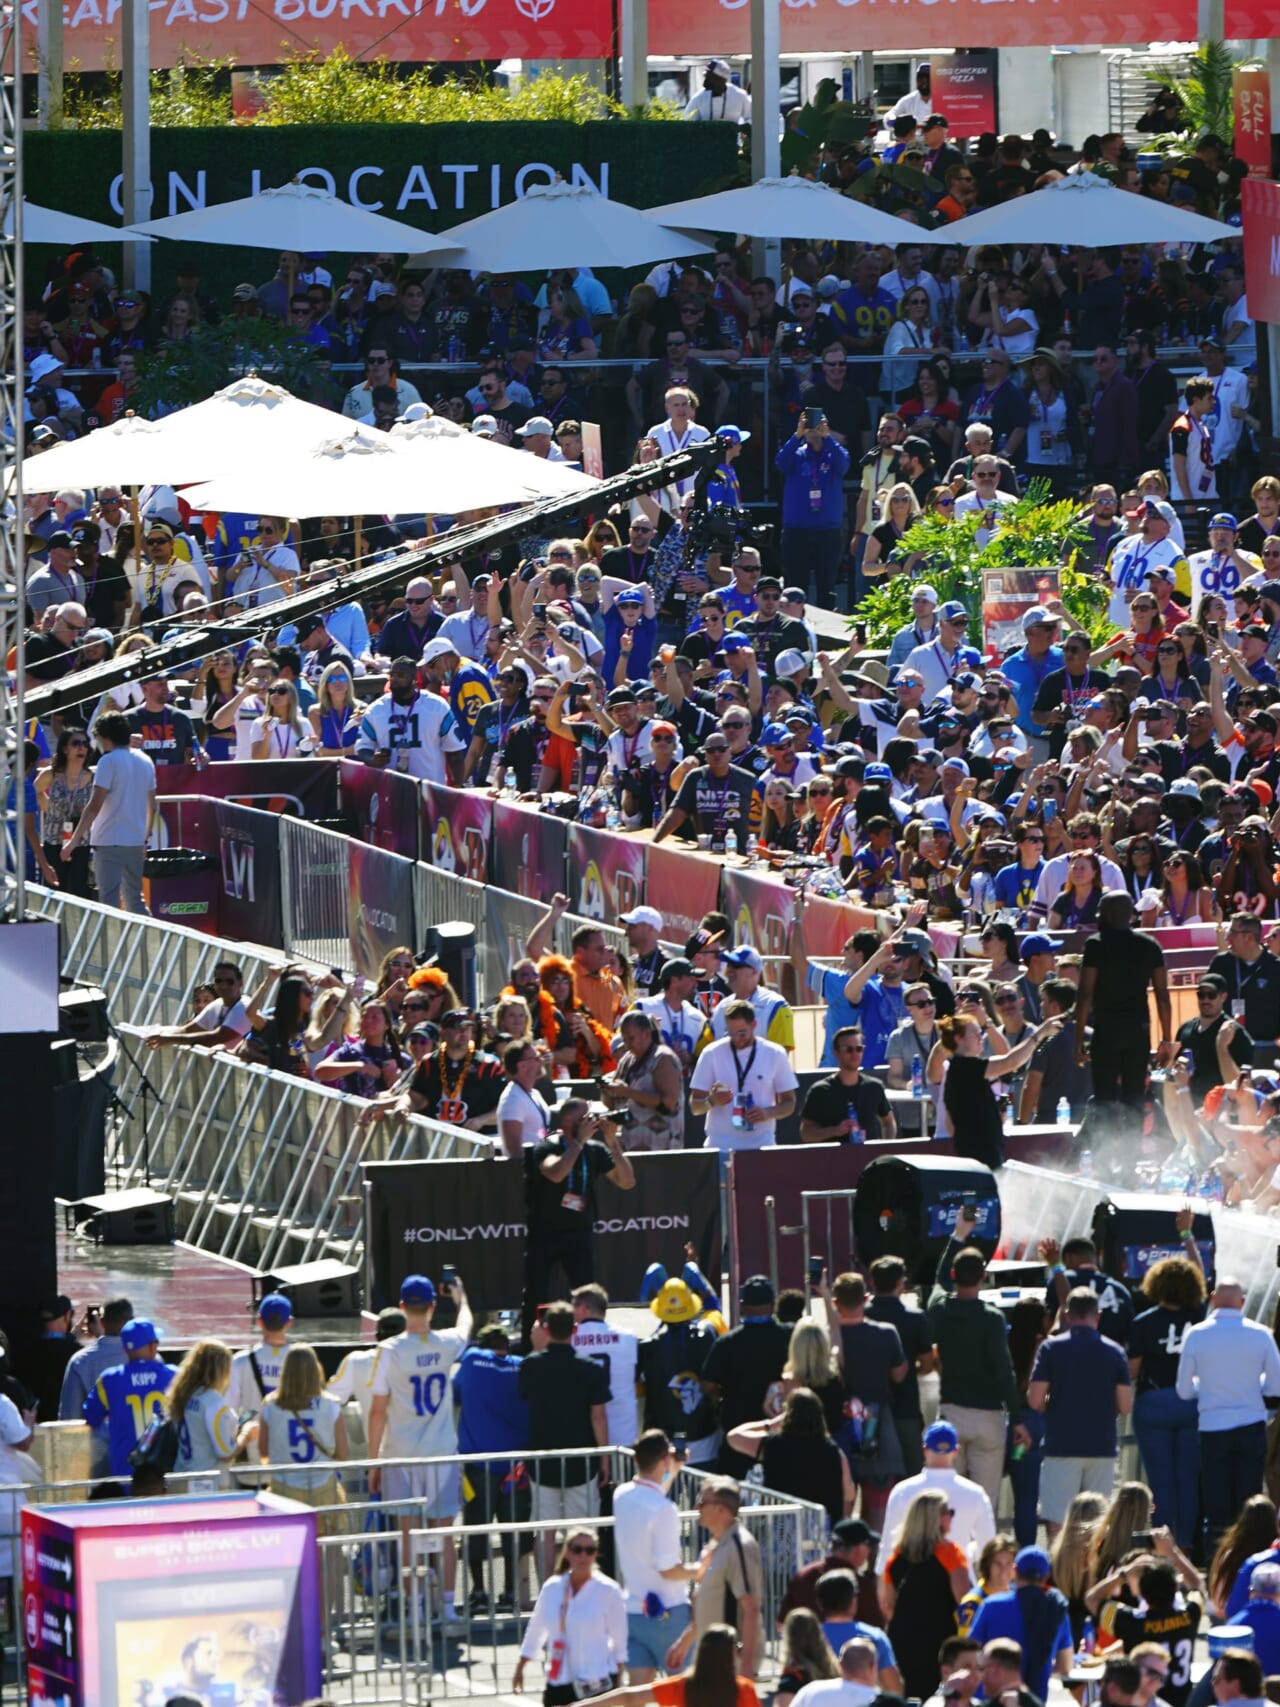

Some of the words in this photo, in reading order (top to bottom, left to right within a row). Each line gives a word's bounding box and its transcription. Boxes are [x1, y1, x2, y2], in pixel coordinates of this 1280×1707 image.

[1253, 90, 1265, 141] FULL
[389, 713, 422, 749] 21
[169, 902, 208, 915] GREEN
[571, 1333, 620, 1347] BURROW
[416, 1352, 443, 1368] KUPP
[130, 1372, 158, 1387] KUPP
[409, 1372, 447, 1417] 10
[126, 1391, 168, 1428] 10
[288, 1418, 316, 1463] 5
[113, 1540, 184, 1560] SUPER
[187, 1535, 249, 1554] BOWL
[251, 1532, 282, 1549] LVI
